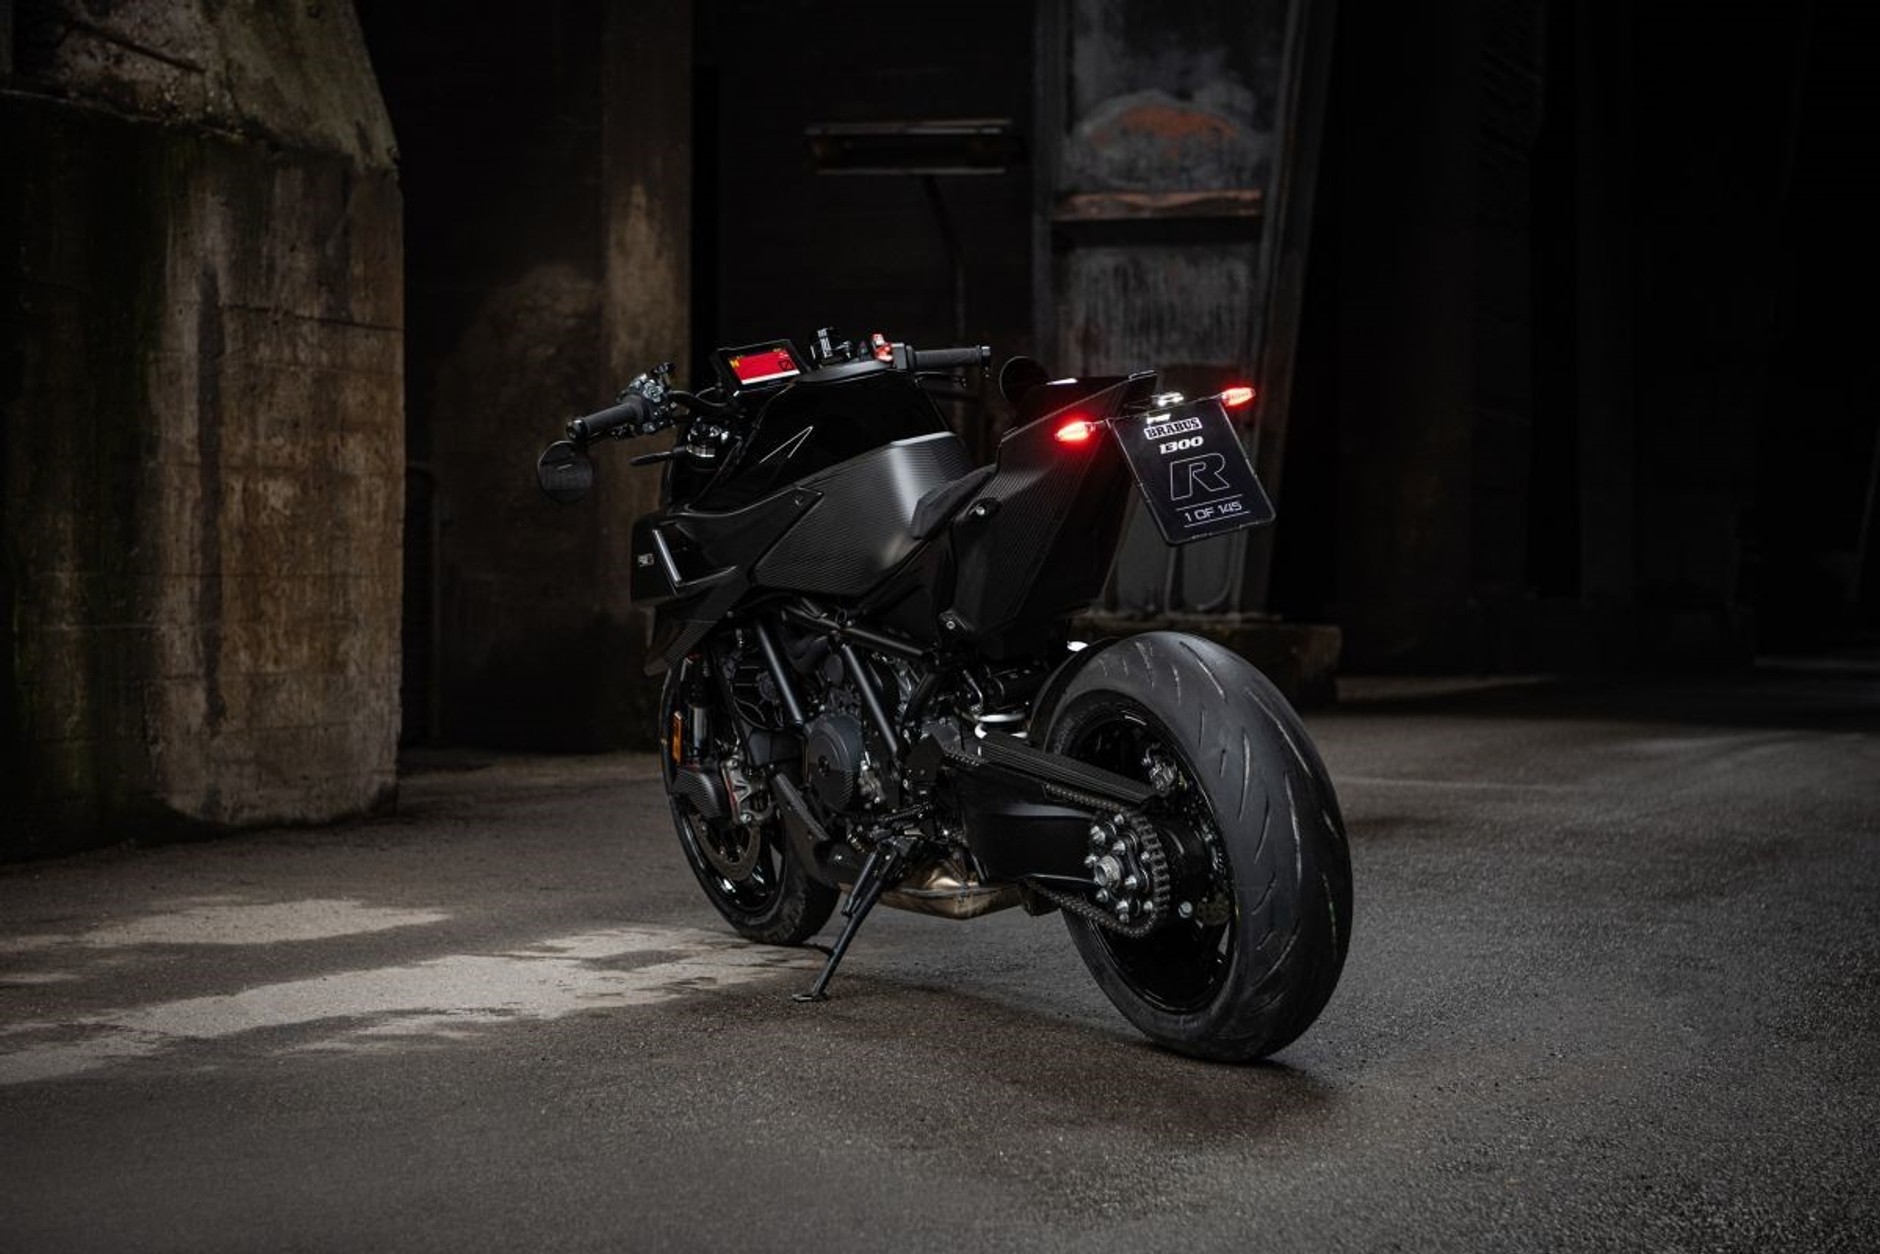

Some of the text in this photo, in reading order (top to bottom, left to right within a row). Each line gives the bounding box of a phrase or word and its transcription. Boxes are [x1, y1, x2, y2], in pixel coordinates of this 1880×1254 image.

[1145, 417, 1201, 439] BRABUS
[1159, 436, 1204, 454] 1300
[1169, 453, 1230, 501] R
[1184, 501, 1243, 522] 1 OF 145
